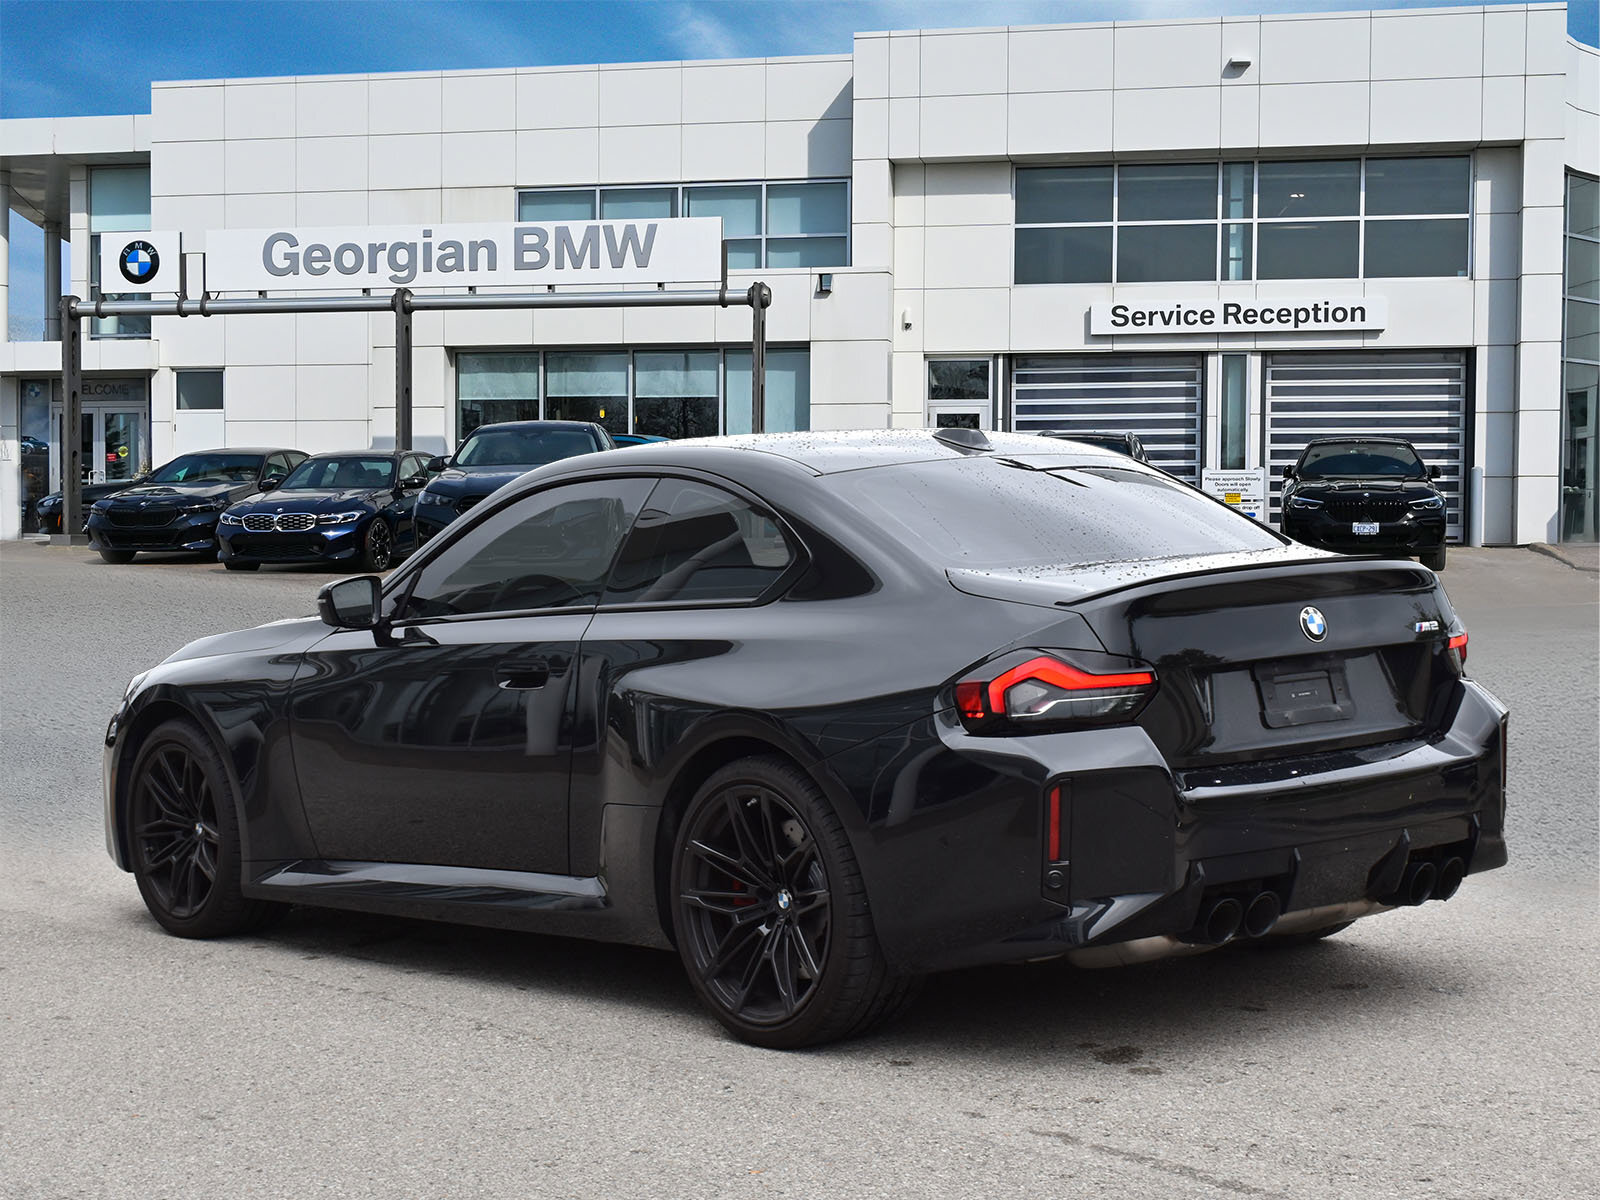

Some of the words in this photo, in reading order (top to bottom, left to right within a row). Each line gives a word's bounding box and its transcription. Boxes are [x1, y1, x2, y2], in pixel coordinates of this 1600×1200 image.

[123, 242, 156, 256] BMW
[262, 229, 496, 284] Georgian
[513, 223, 658, 271] BMW
[1110, 304, 1215, 328] Service
[1223, 301, 1366, 329] Reception
[81, 384, 129, 395] ELCOME
